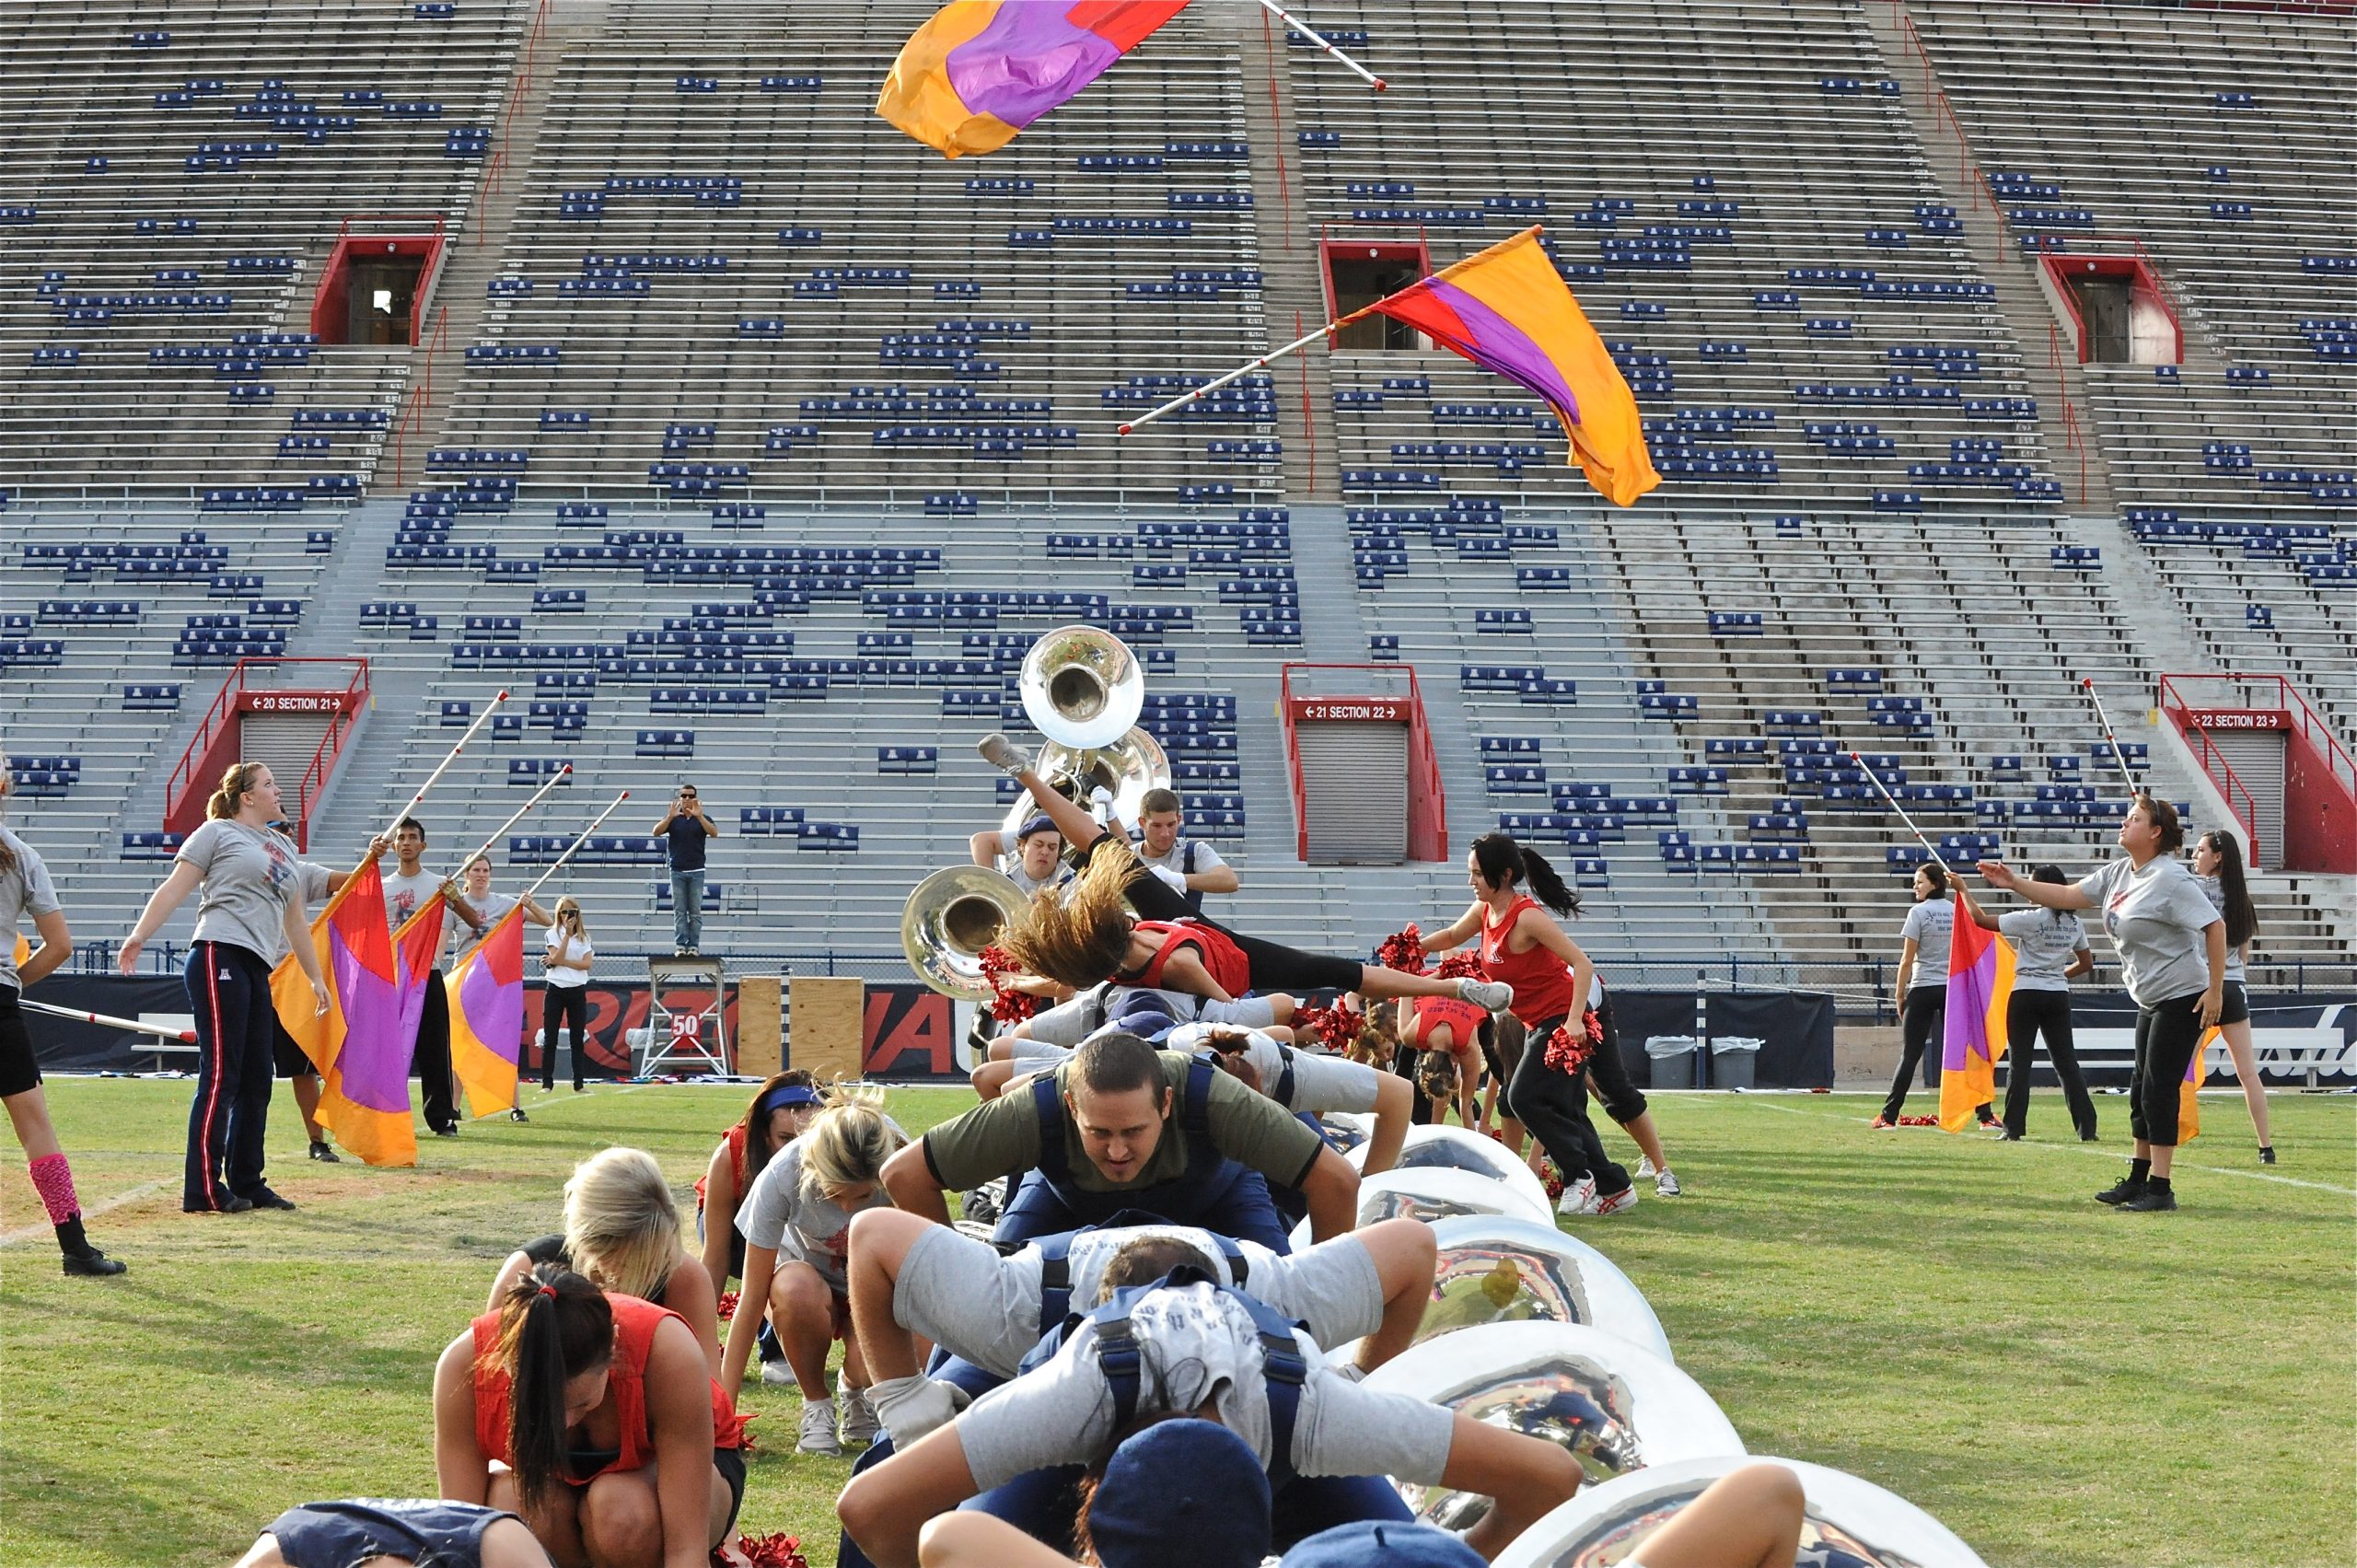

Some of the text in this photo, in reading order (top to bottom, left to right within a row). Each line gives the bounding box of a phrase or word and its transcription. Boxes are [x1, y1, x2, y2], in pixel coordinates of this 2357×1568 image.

[262, 697, 331, 710] 20 SECTION 21
[1317, 706, 1385, 718] 21 SECTION 22
[2201, 714, 2268, 726] 22 SECTION 23
[522, 989, 952, 1074] ARIZA
[673, 1015, 697, 1035] 50
